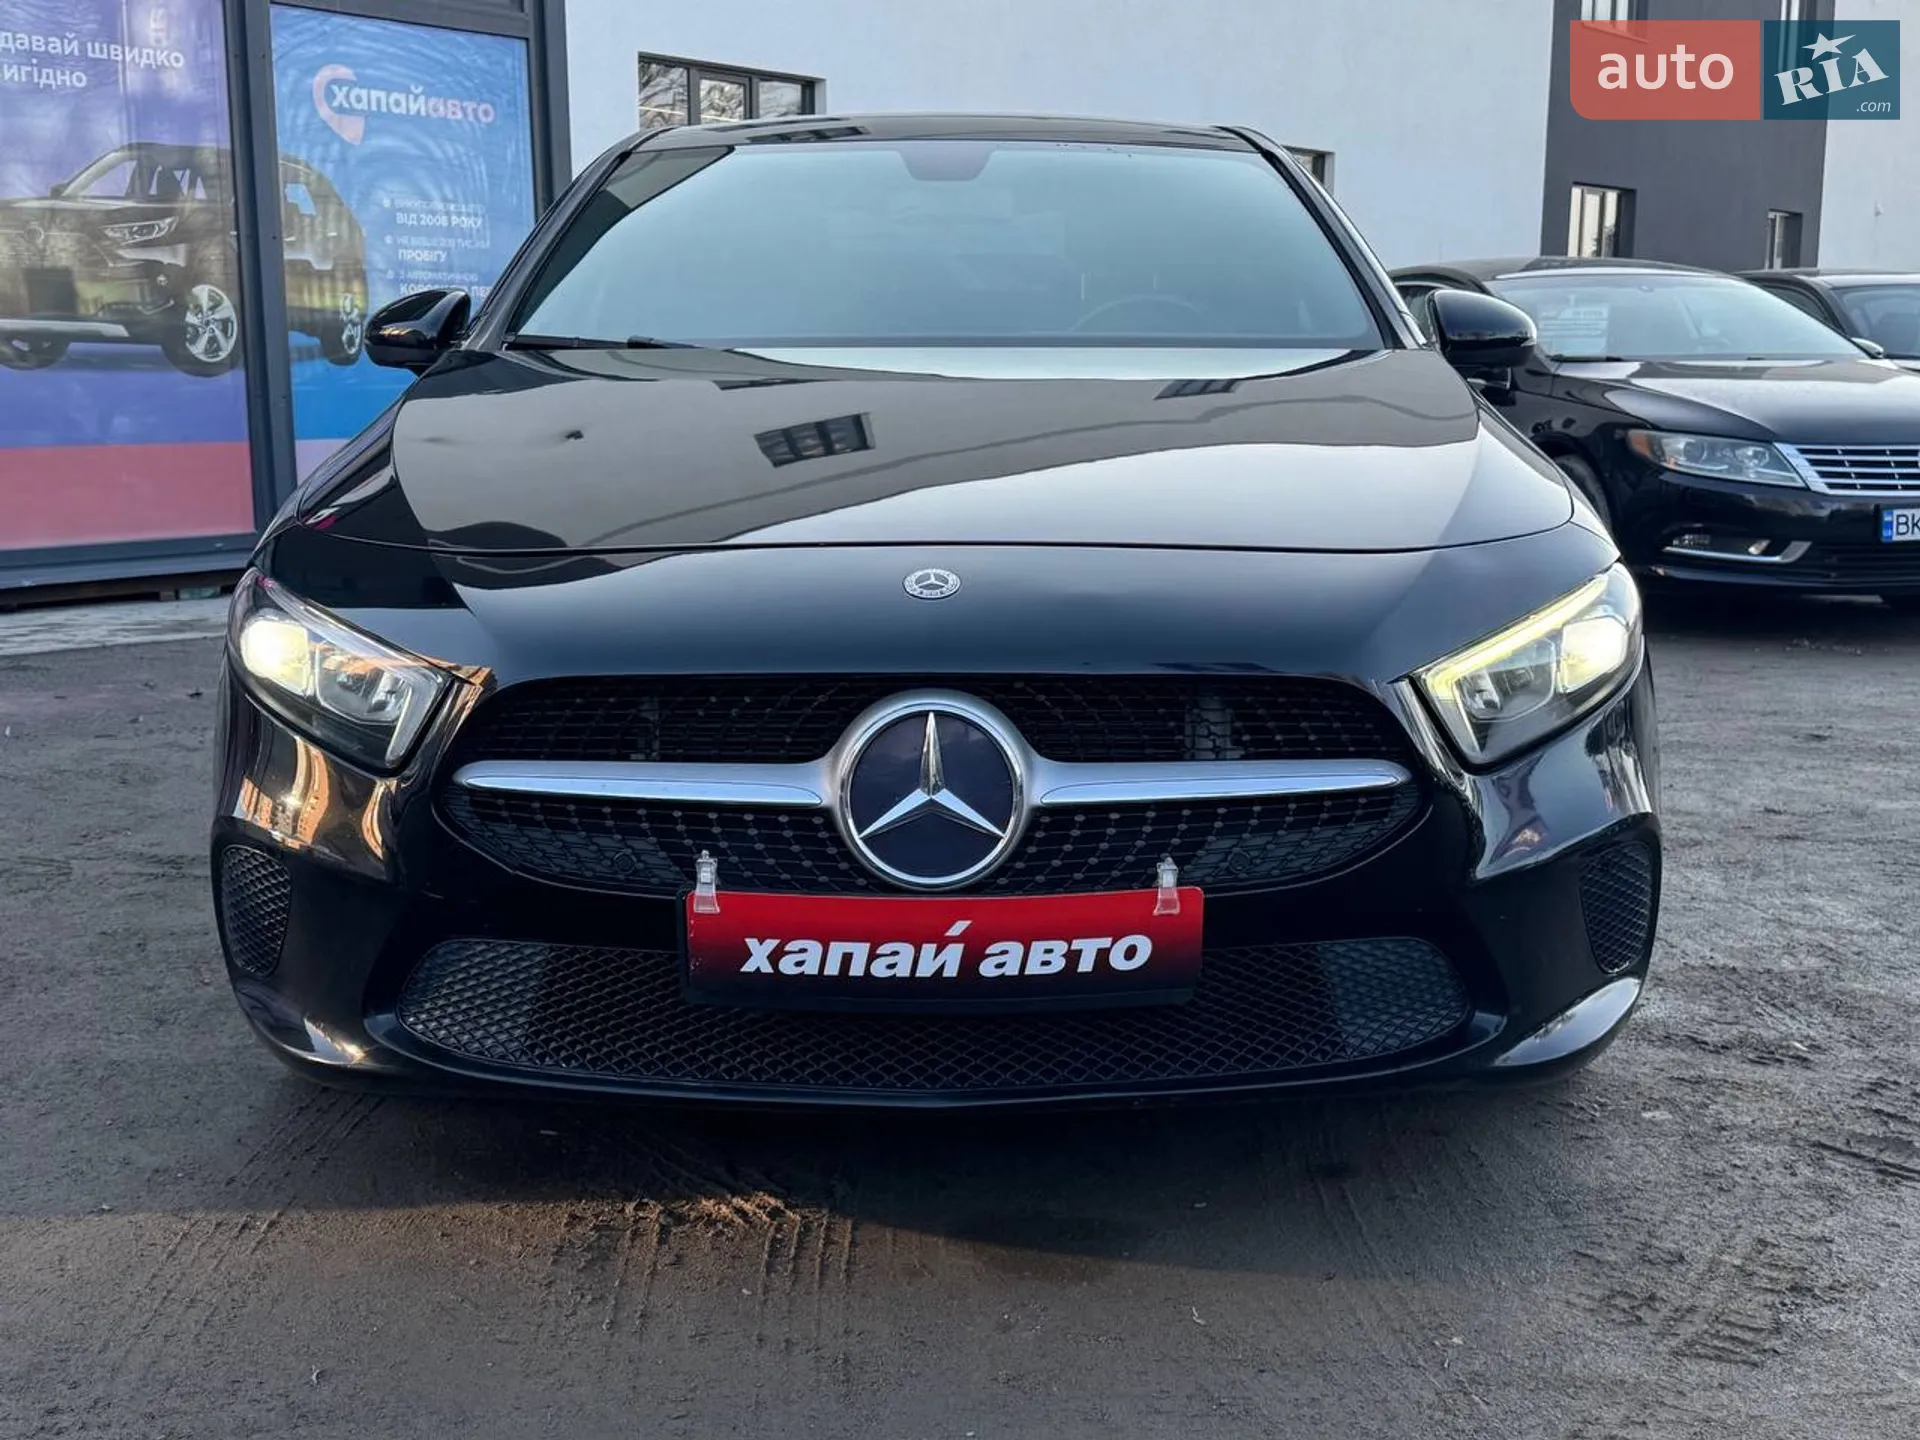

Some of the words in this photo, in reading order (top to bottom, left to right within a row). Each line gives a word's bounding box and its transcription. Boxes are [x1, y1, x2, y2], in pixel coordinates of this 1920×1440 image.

[87, 41, 185, 69] швидко
[0, 58, 87, 89] игідно
[396, 212, 418, 227] ВІД
[451, 216, 483, 229] РОКУ
[398, 249, 447, 263] ПРОБІГУ
[978, 933, 1154, 977] авто
